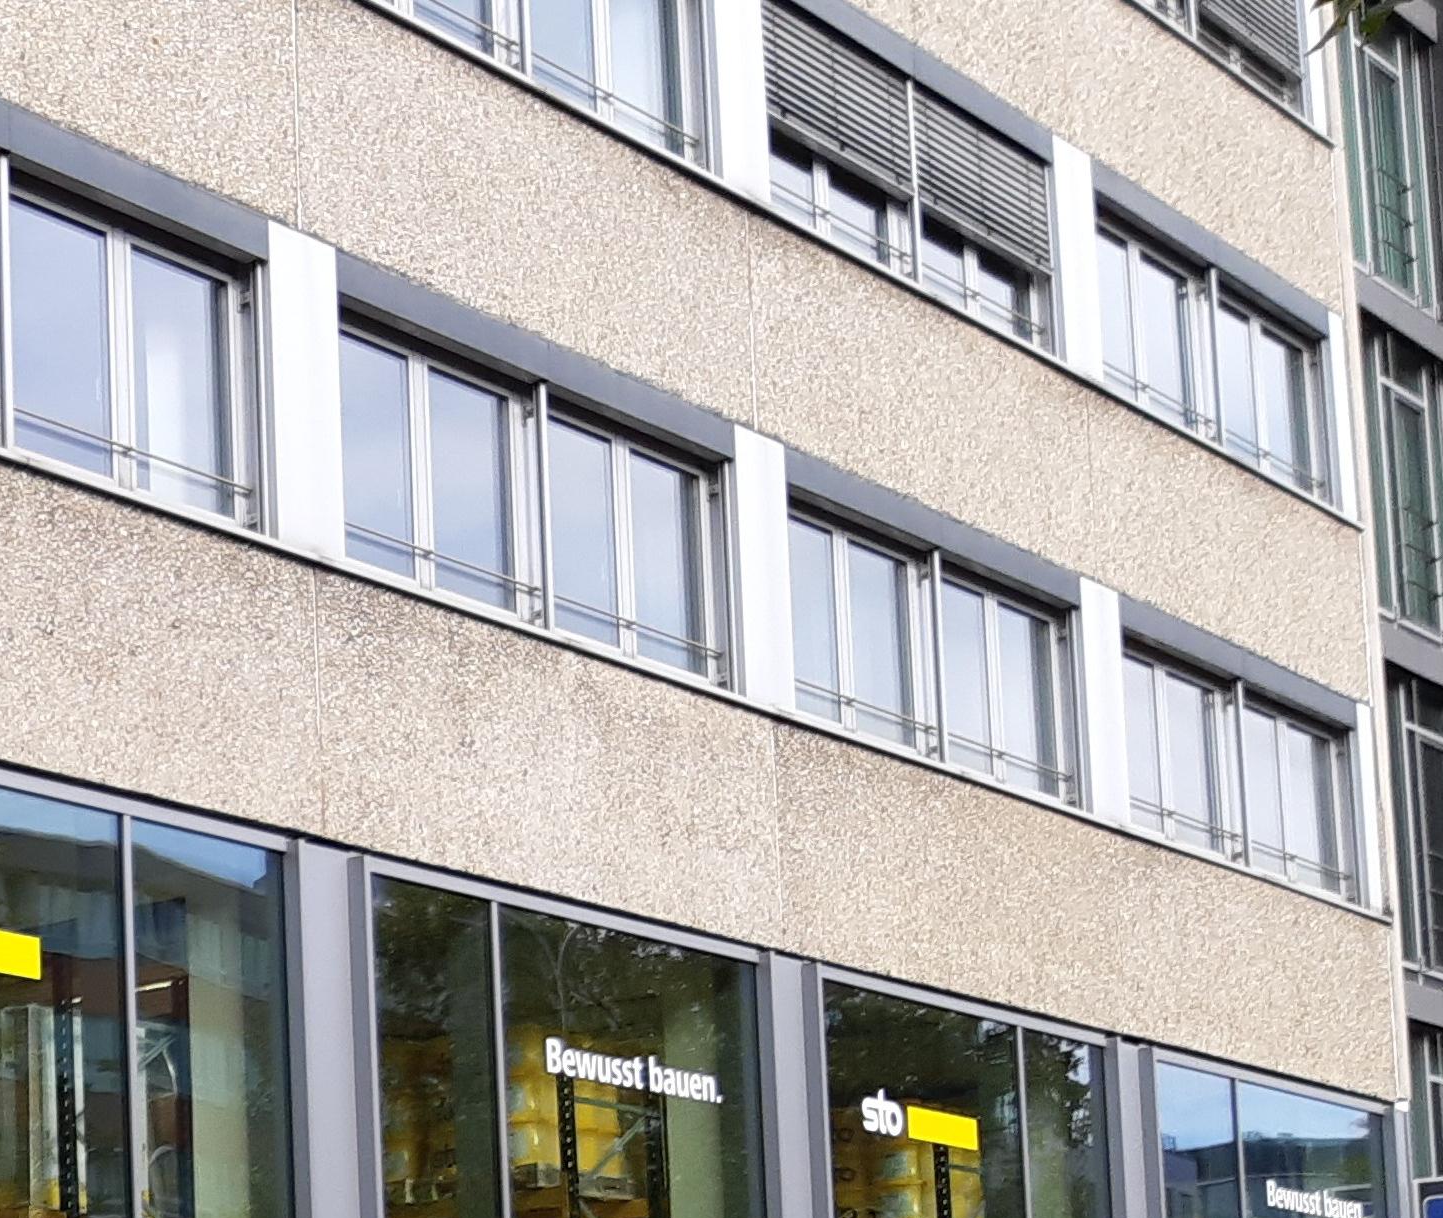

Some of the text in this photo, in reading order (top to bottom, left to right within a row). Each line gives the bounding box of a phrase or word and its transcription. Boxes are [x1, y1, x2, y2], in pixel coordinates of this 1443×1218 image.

[545, 1036, 724, 1104] Bewusst bauen.
[861, 1087, 903, 1137] sto
[1266, 1179, 1323, 1217] Bewusst
